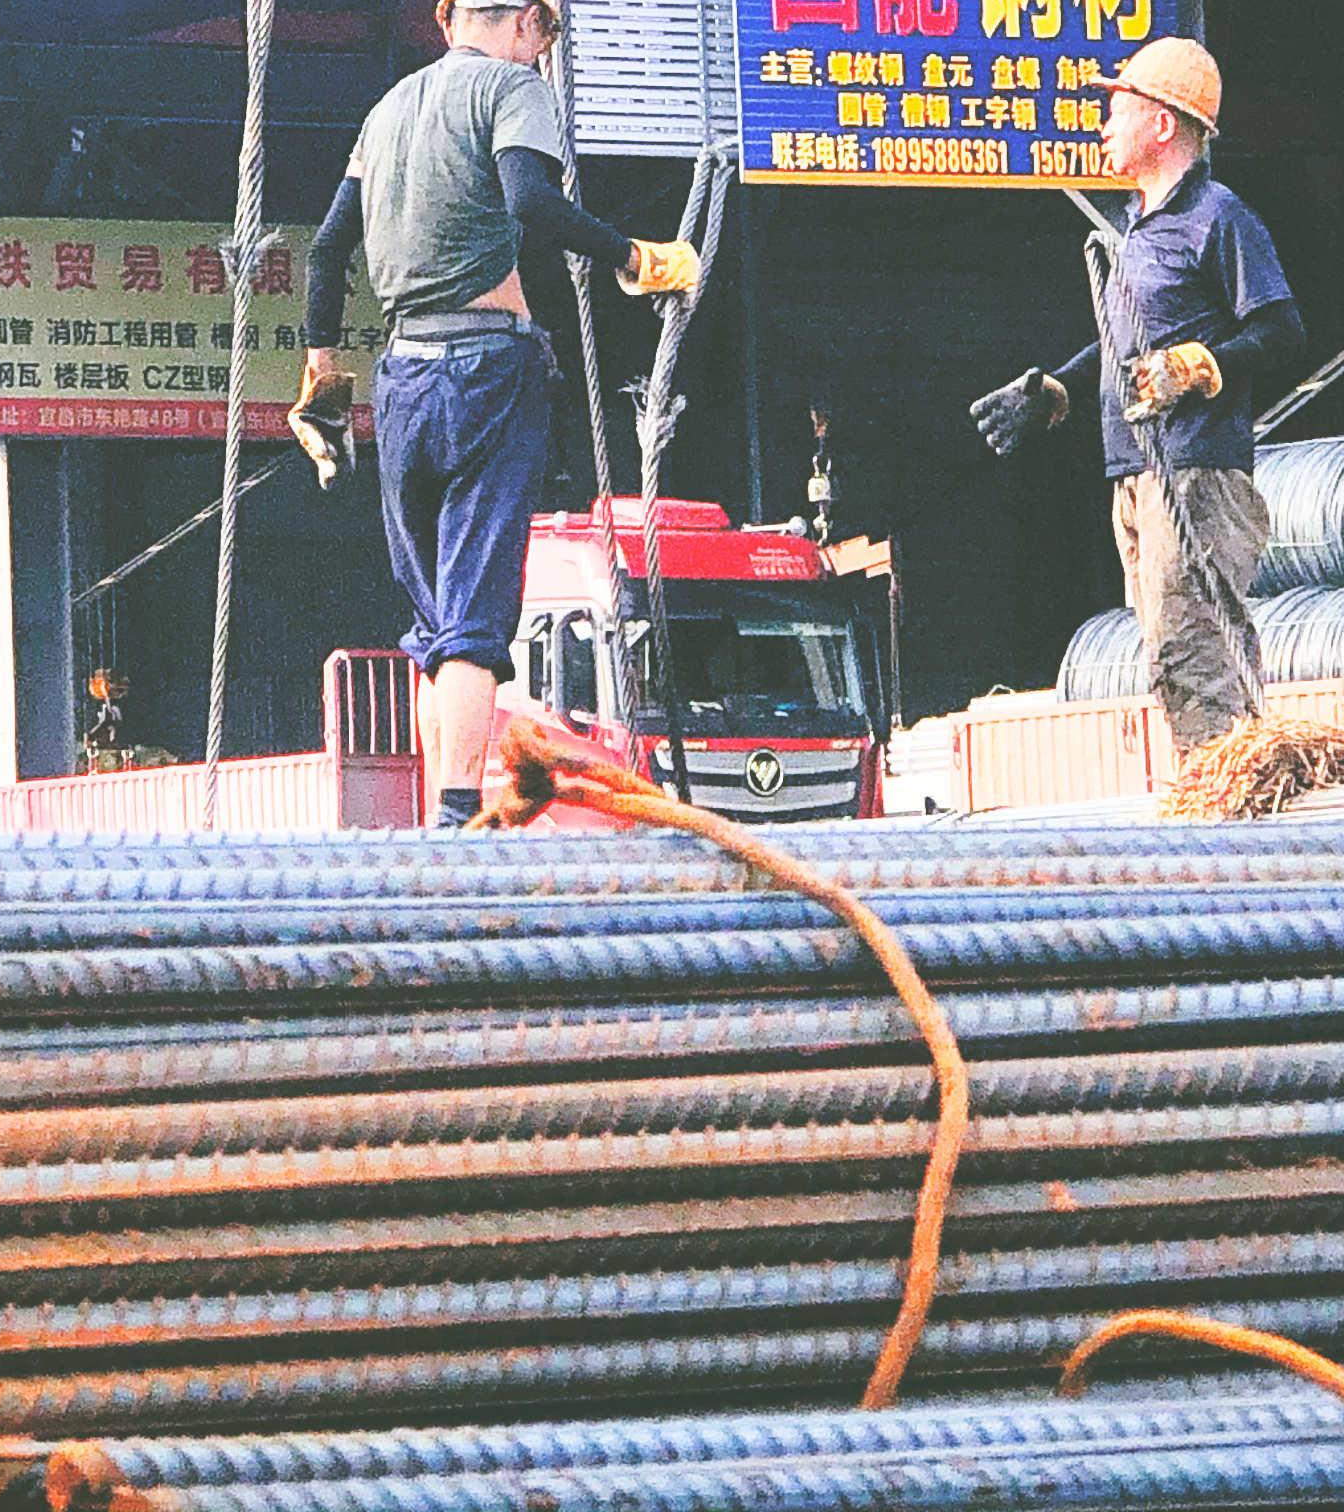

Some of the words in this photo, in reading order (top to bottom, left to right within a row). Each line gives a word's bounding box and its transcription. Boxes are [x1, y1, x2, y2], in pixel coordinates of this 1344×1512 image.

[961, 95, 1036, 130] 工字钢
[55, 364, 129, 391] 楼层板
